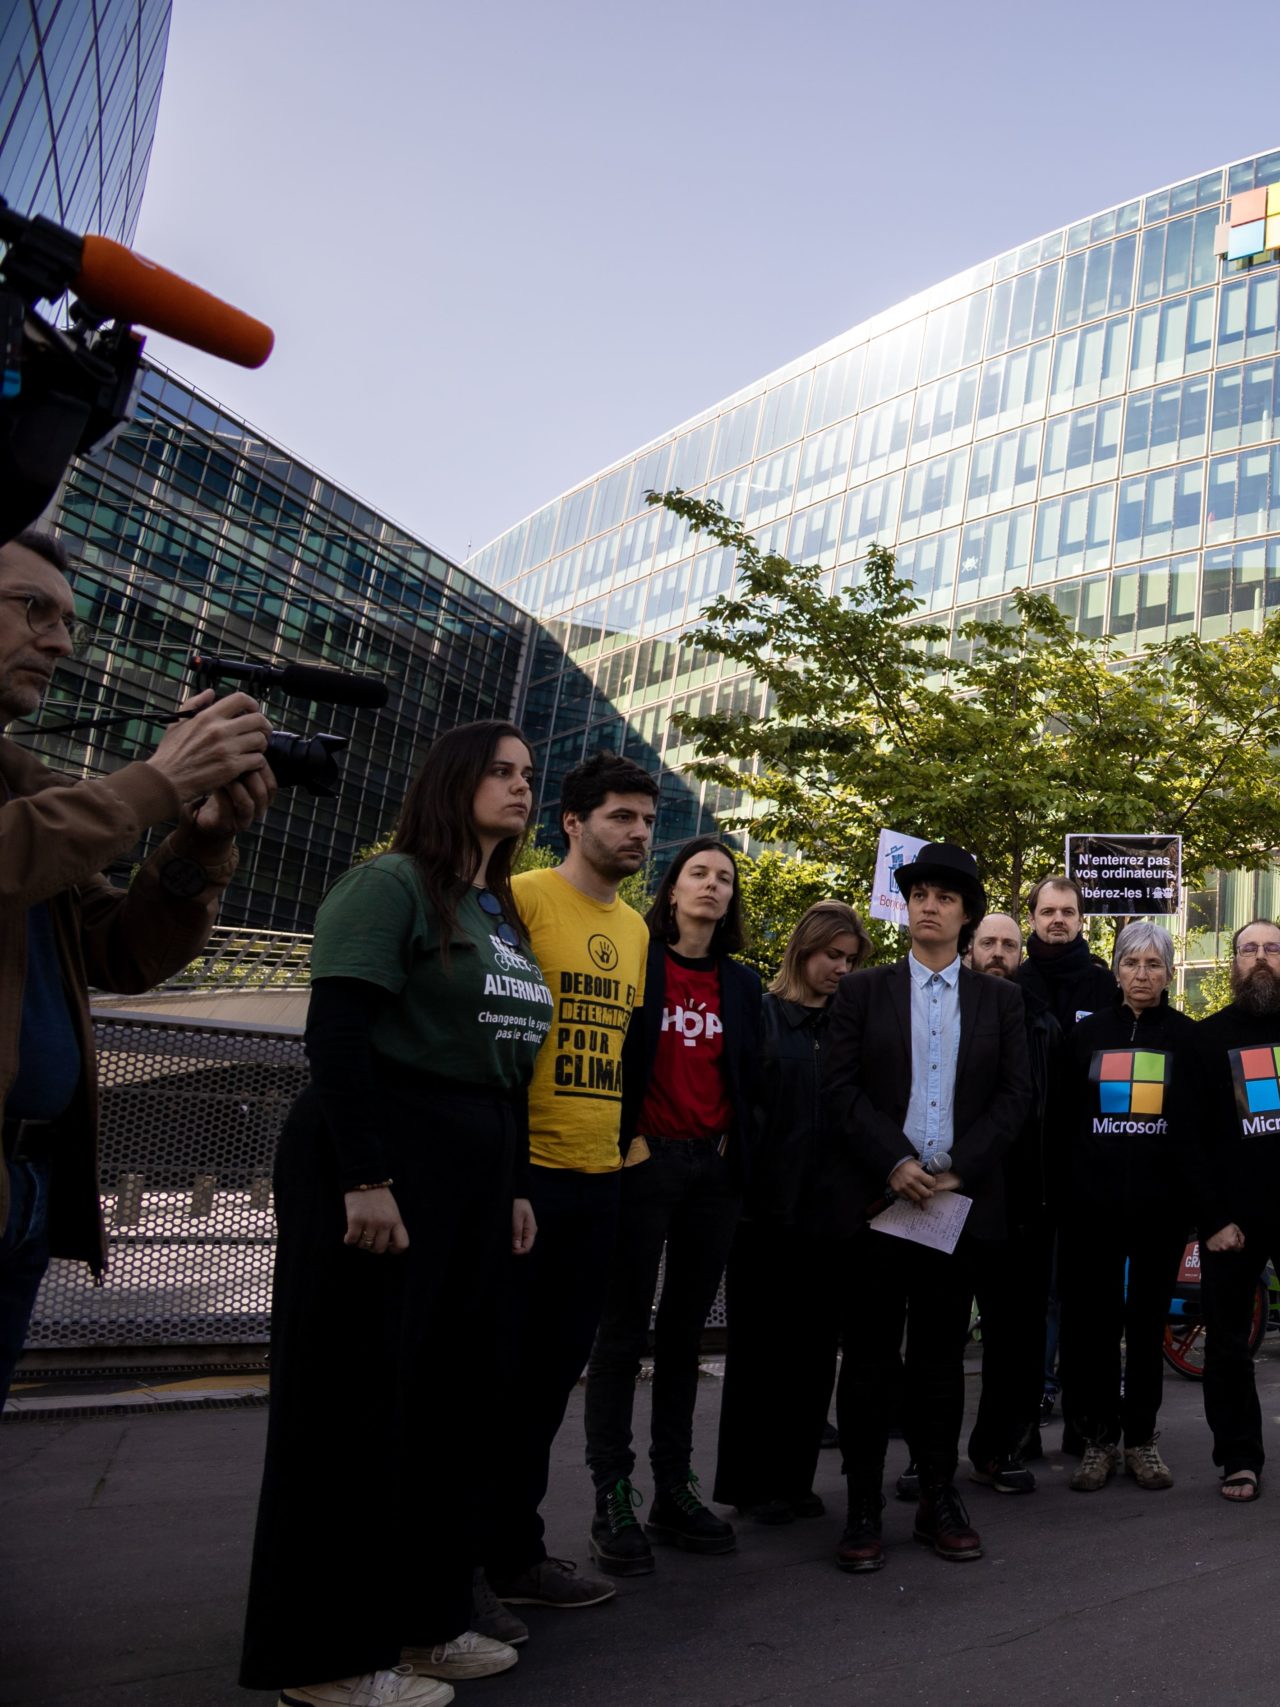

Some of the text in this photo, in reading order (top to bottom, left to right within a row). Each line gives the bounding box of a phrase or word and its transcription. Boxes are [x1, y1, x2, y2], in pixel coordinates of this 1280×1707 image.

[1078, 854, 1171, 868] N'enterrez pas
[1075, 869, 1098, 879] vos
[1081, 887, 1142, 898] ibérez-les
[483, 973, 554, 1007] ALTERNATI
[560, 971, 621, 1001] DEBOUT
[478, 1011, 527, 1026] Changeons
[528, 1015, 536, 1027] le
[661, 1004, 723, 1041] HOP
[495, 1028, 513, 1040] pas
[513, 1027, 521, 1039] le
[558, 1028, 609, 1054] POUR
[554, 1054, 623, 1093] CLIMA
[1092, 1117, 1168, 1135] Microsoft
